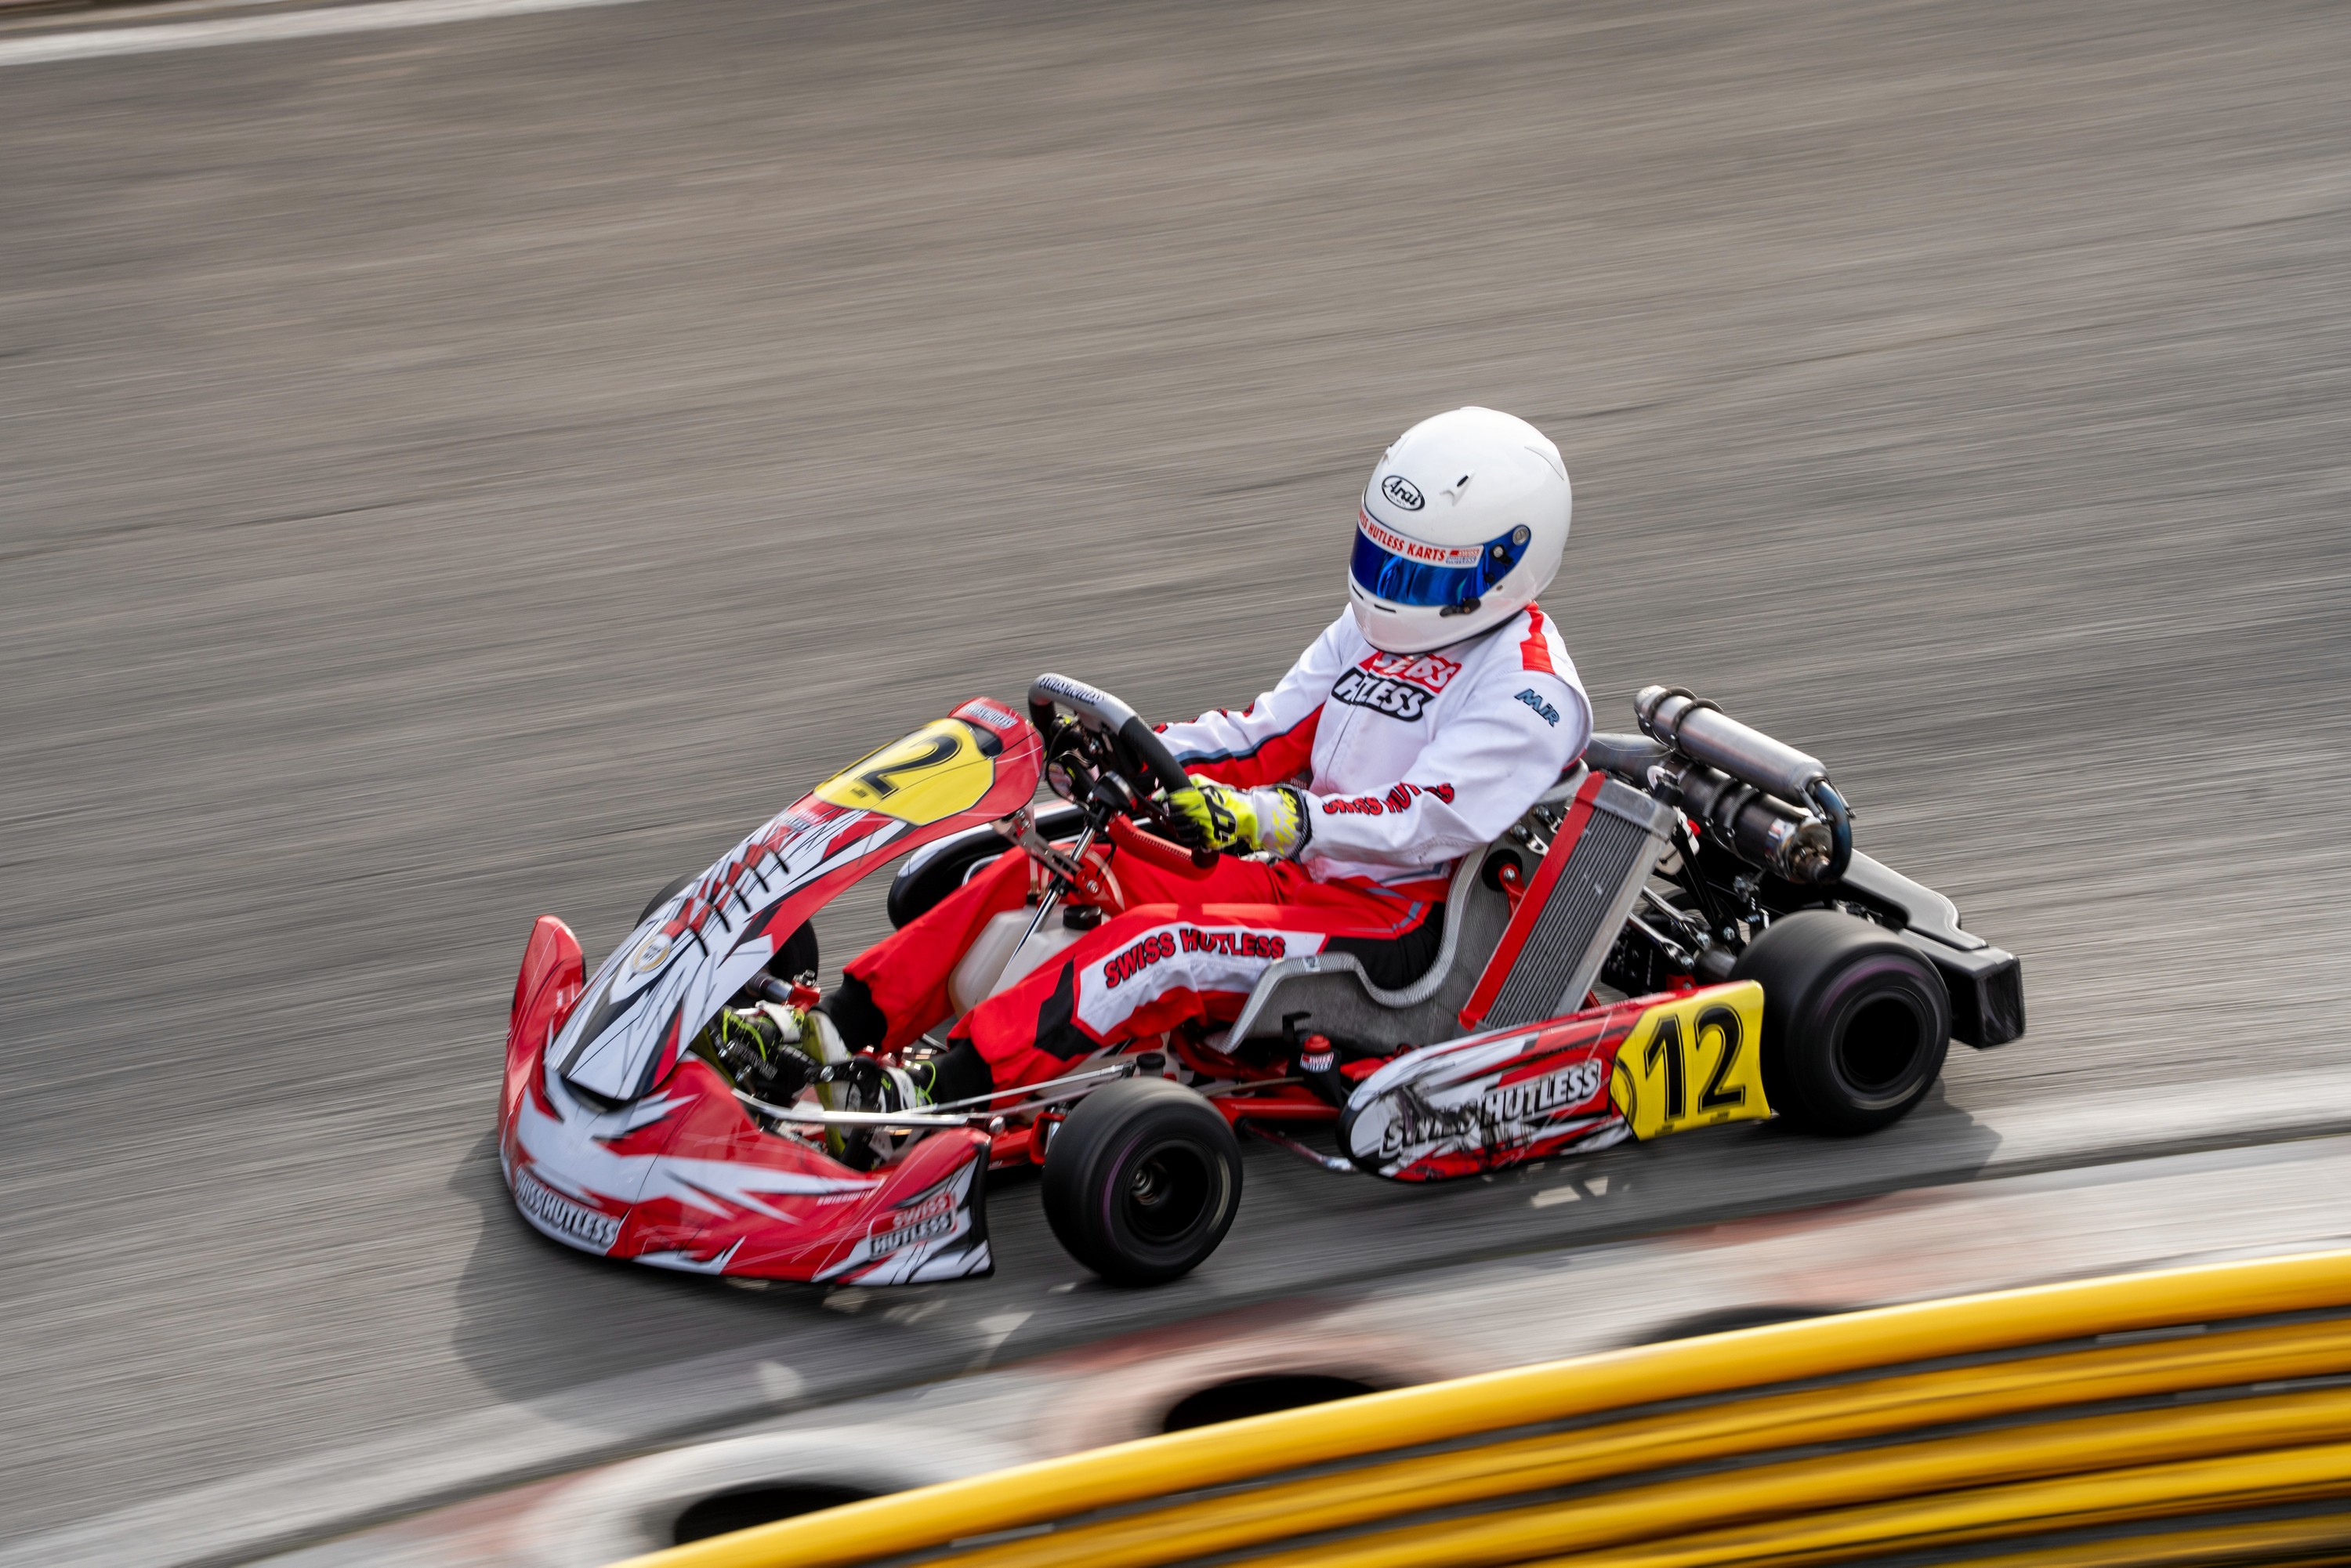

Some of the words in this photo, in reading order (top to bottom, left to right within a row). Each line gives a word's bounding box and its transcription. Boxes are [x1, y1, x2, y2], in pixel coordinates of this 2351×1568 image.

[1383, 478, 1420, 505] Arai
[1407, 541, 1446, 562] KARTS
[1103, 932, 1176, 989] SWISS
[1179, 927, 1287, 960] HUTLESS
[1643, 1001, 1747, 1122] 12
[1483, 1060, 1601, 1124] HUTLESS
[541, 1190, 621, 1248] HUTLESS
